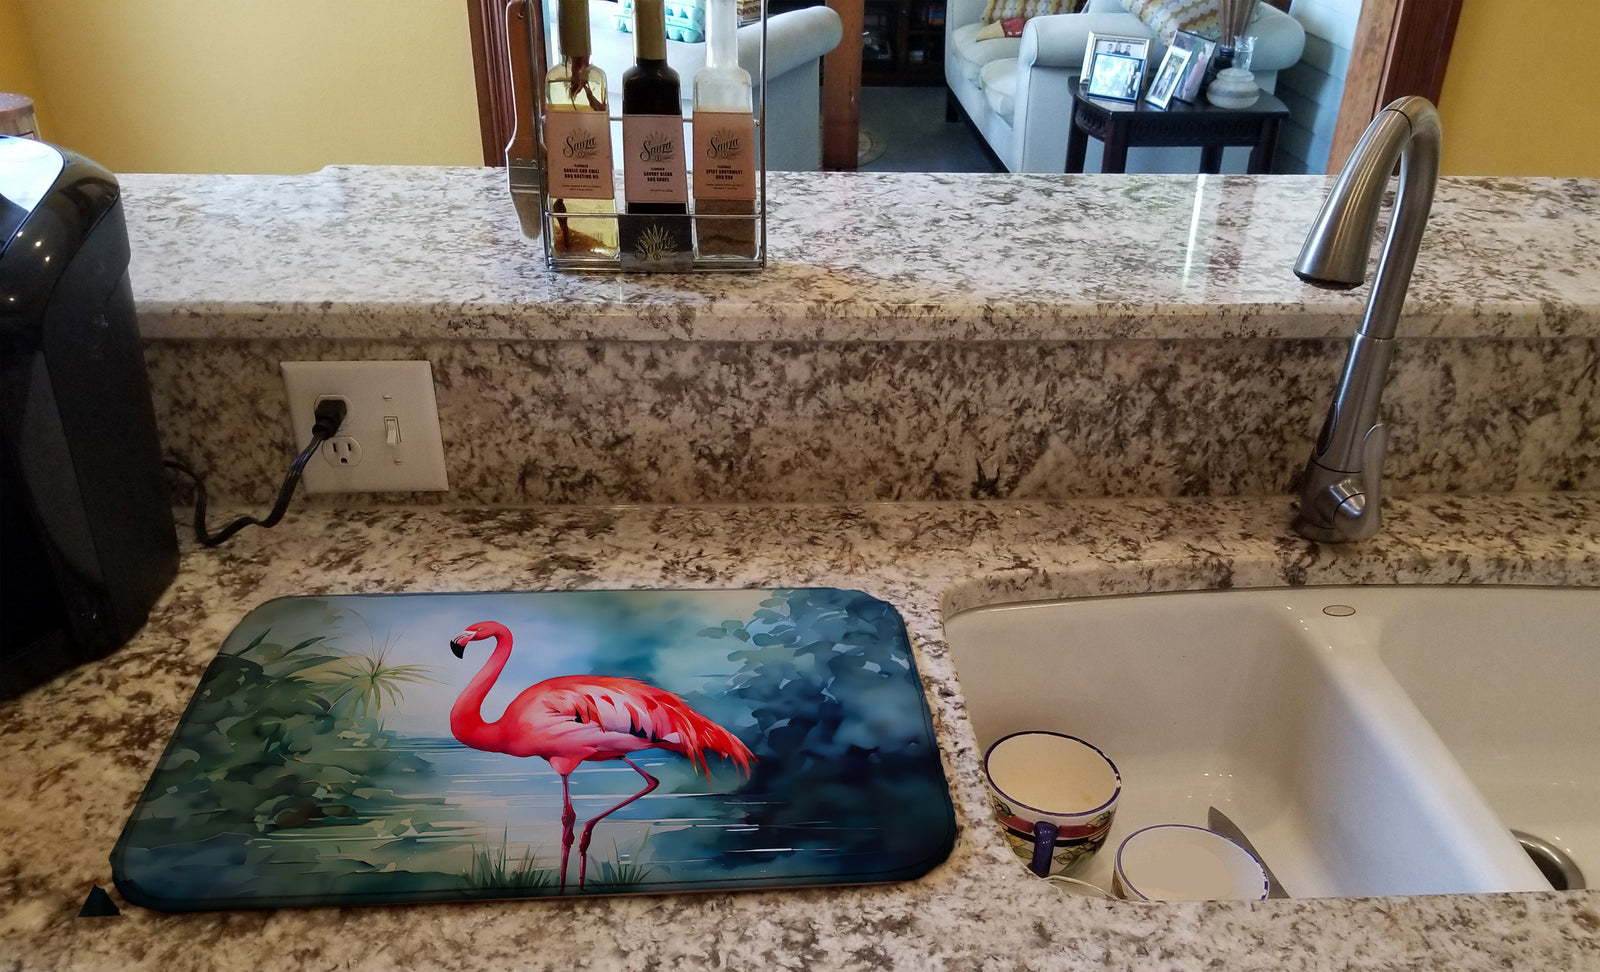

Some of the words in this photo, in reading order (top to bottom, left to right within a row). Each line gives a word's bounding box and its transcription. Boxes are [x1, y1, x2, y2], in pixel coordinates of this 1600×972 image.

[562, 136, 598, 158] Sauza
[639, 139, 674, 161] Sauza
[706, 136, 740, 158] Sauza
